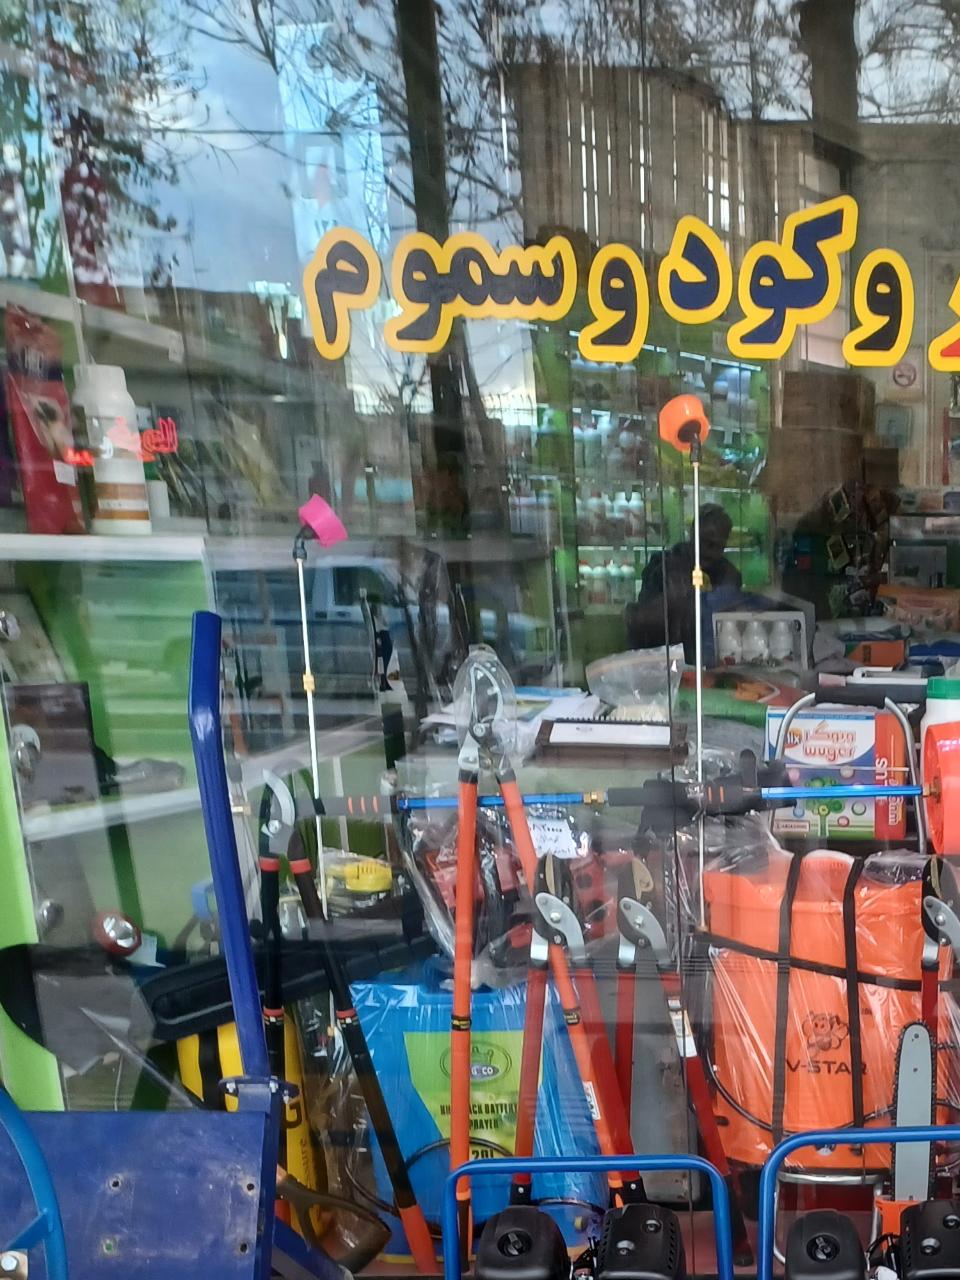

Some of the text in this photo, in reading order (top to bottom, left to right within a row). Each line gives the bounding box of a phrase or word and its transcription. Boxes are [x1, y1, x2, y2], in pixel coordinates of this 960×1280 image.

[303, 227, 577, 360] سموم
[578, 243, 649, 362] و
[658, 195, 858, 359] کود
[842, 248, 914, 366] و
[440, 1104, 483, 1115] KNACK
[469, 1118, 500, 1131] PRAYER
[481, 1066, 494, 1075] CO
